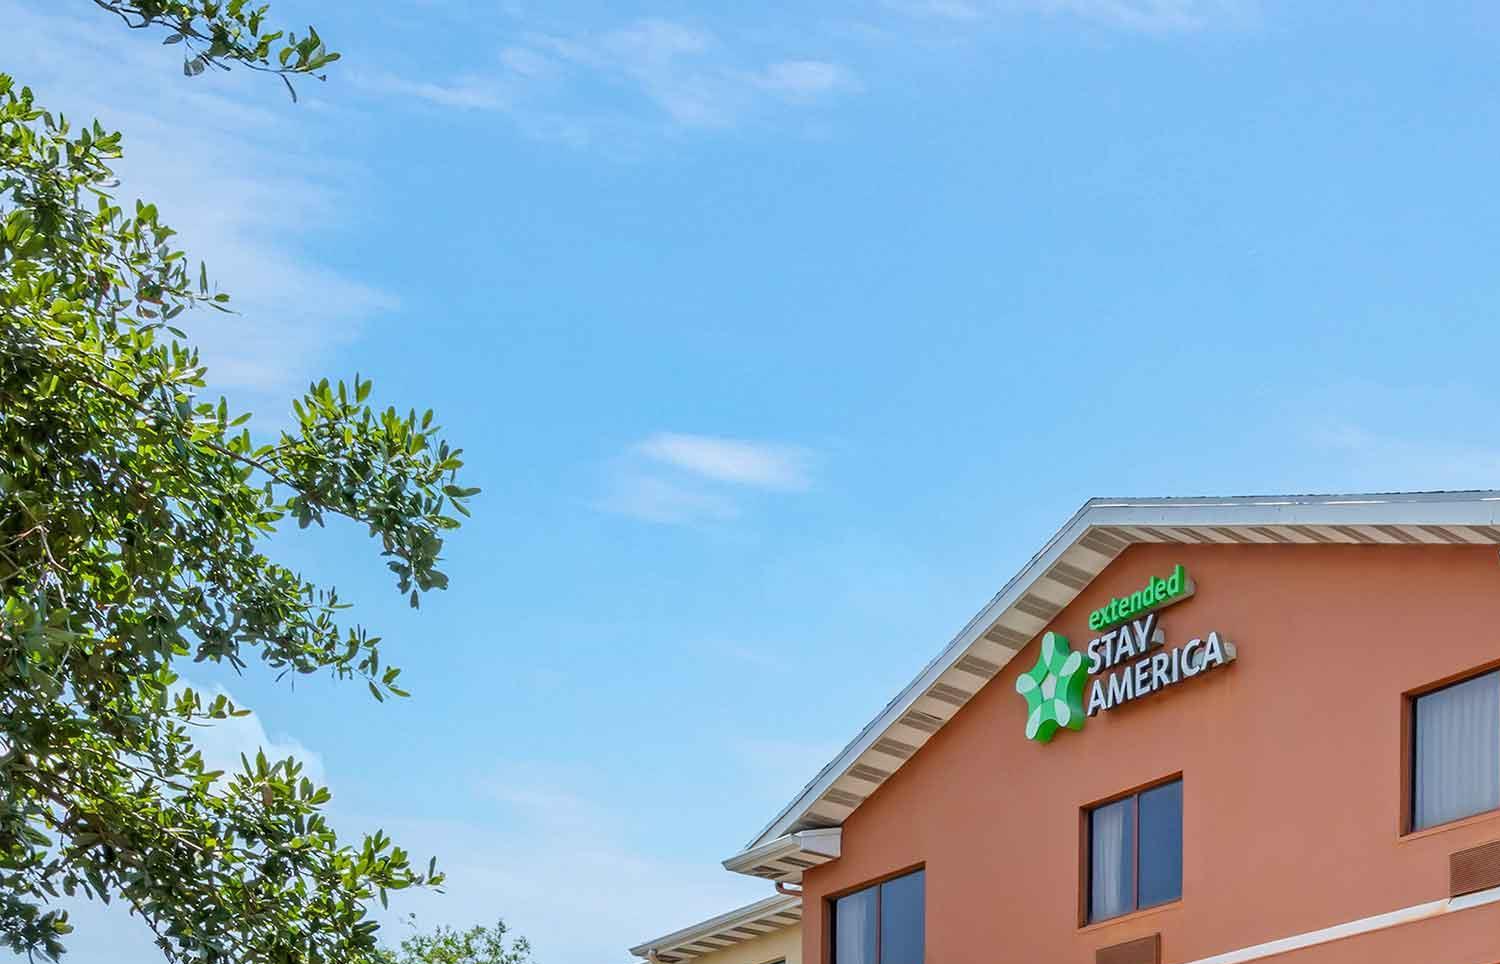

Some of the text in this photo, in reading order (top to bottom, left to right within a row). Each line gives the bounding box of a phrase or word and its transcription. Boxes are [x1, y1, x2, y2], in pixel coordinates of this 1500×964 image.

[1088, 564, 1186, 631] extended
[1087, 613, 1155, 675] STAY
[1087, 631, 1224, 717] AMERICA
